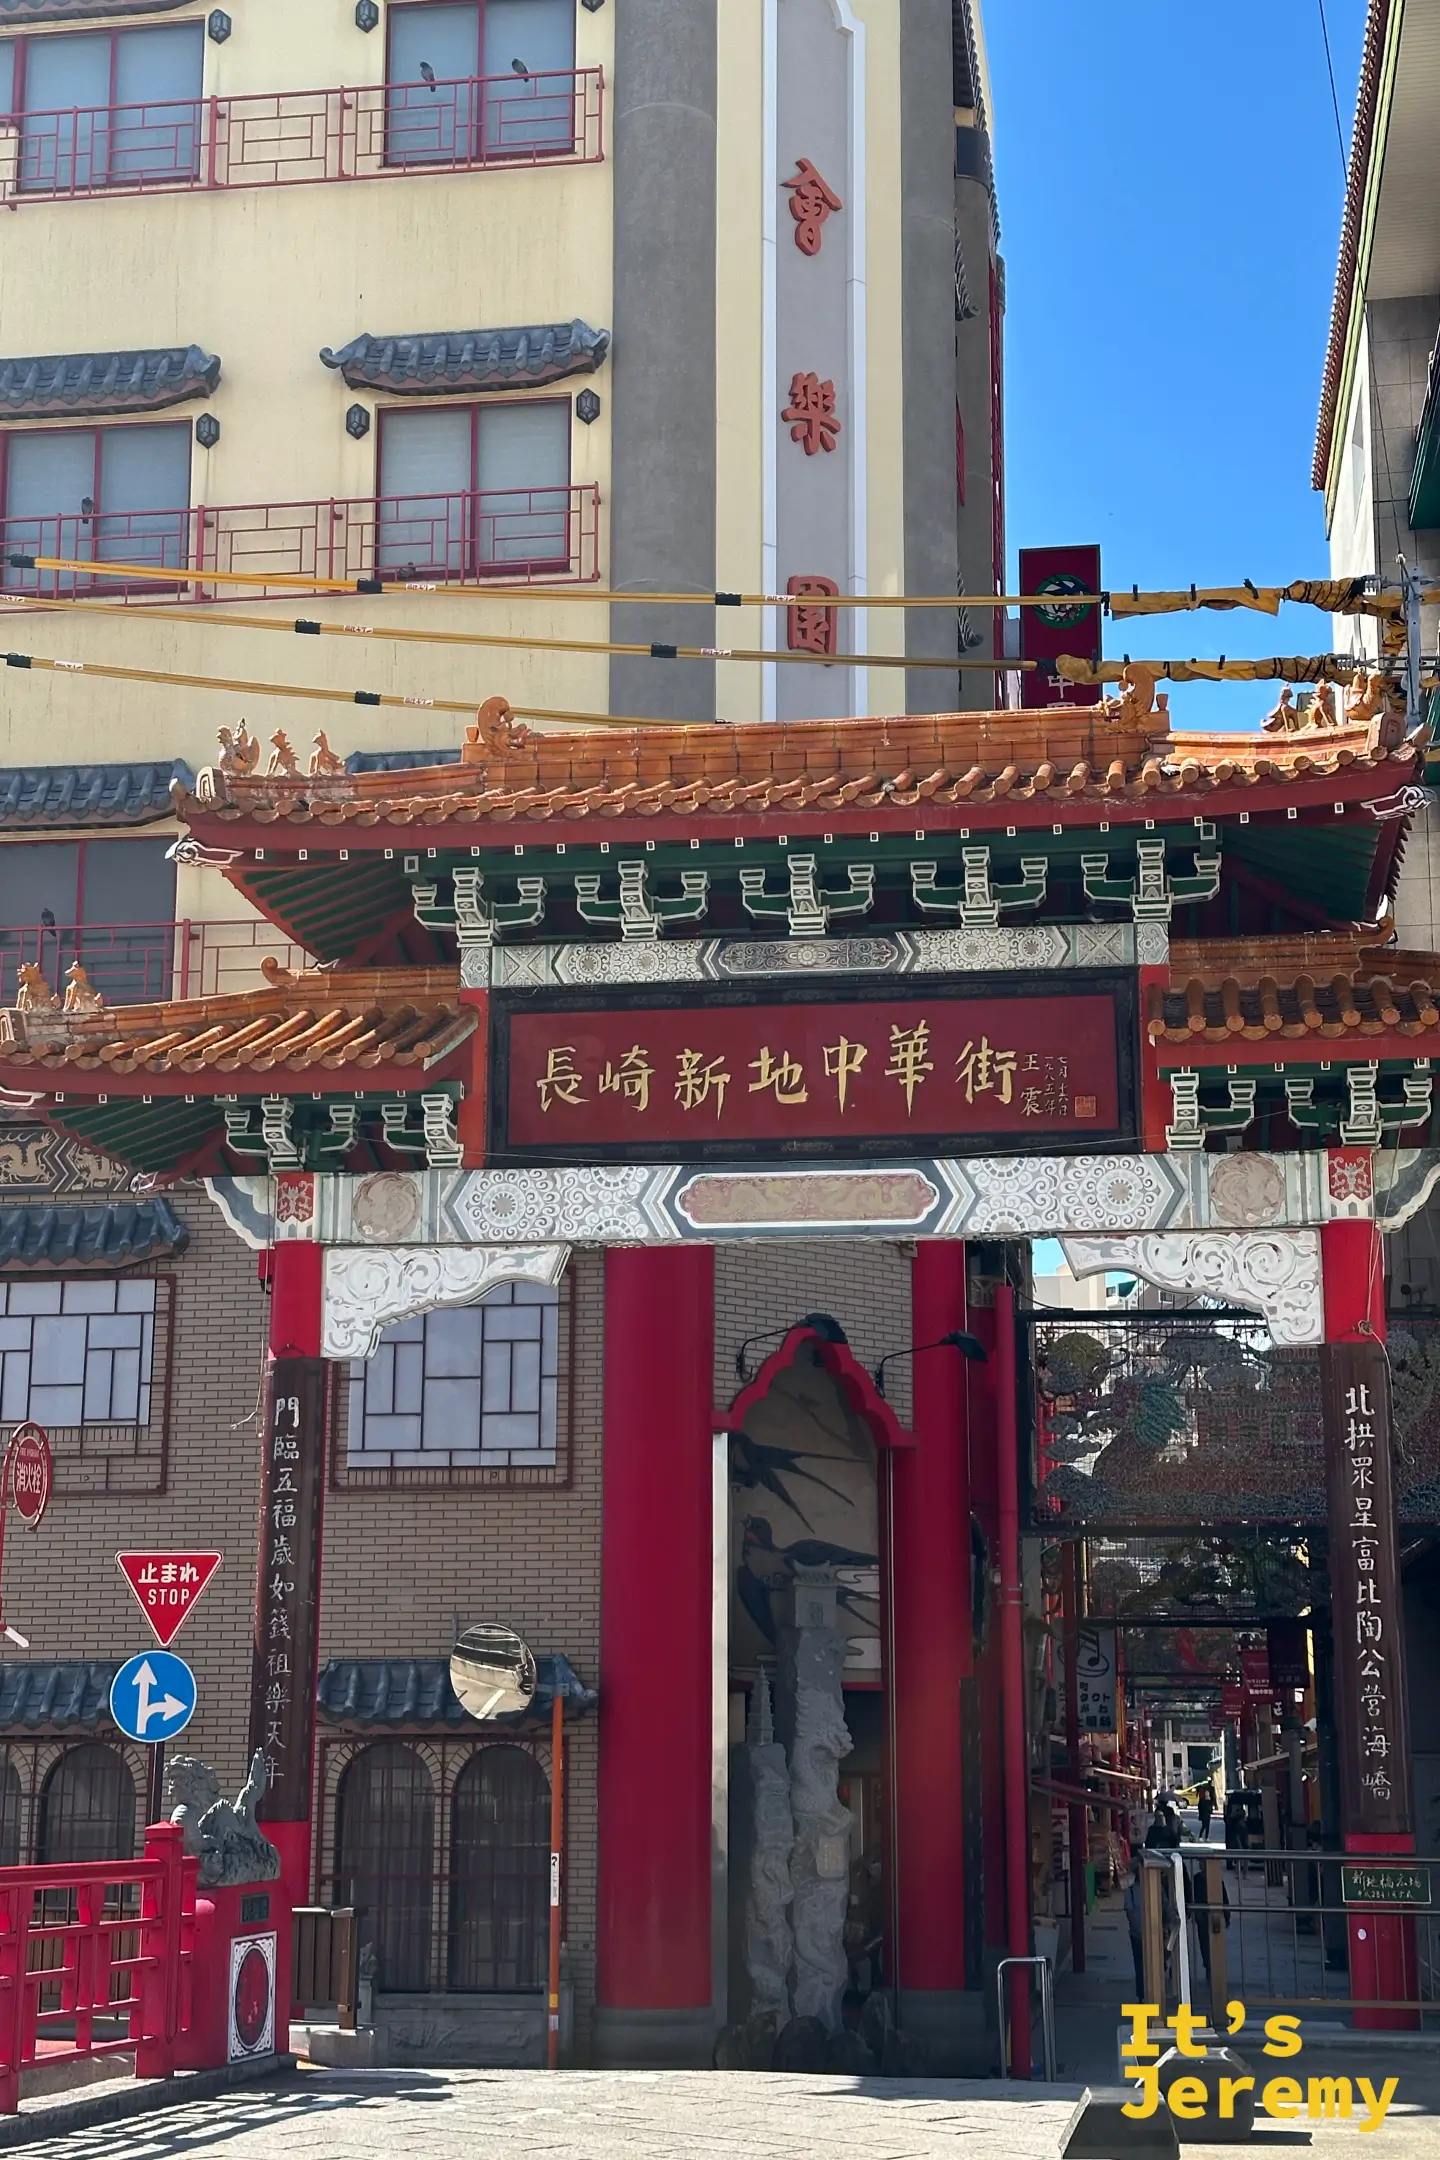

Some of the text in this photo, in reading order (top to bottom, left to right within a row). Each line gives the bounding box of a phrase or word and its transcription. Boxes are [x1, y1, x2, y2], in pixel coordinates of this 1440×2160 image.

[535, 1018, 1018, 1121] 長崎新地中華街
[16, 1462, 41, 1494] 消火栓
[138, 1562, 199, 1583] 止まれ
[148, 1588, 190, 1605] STOP
